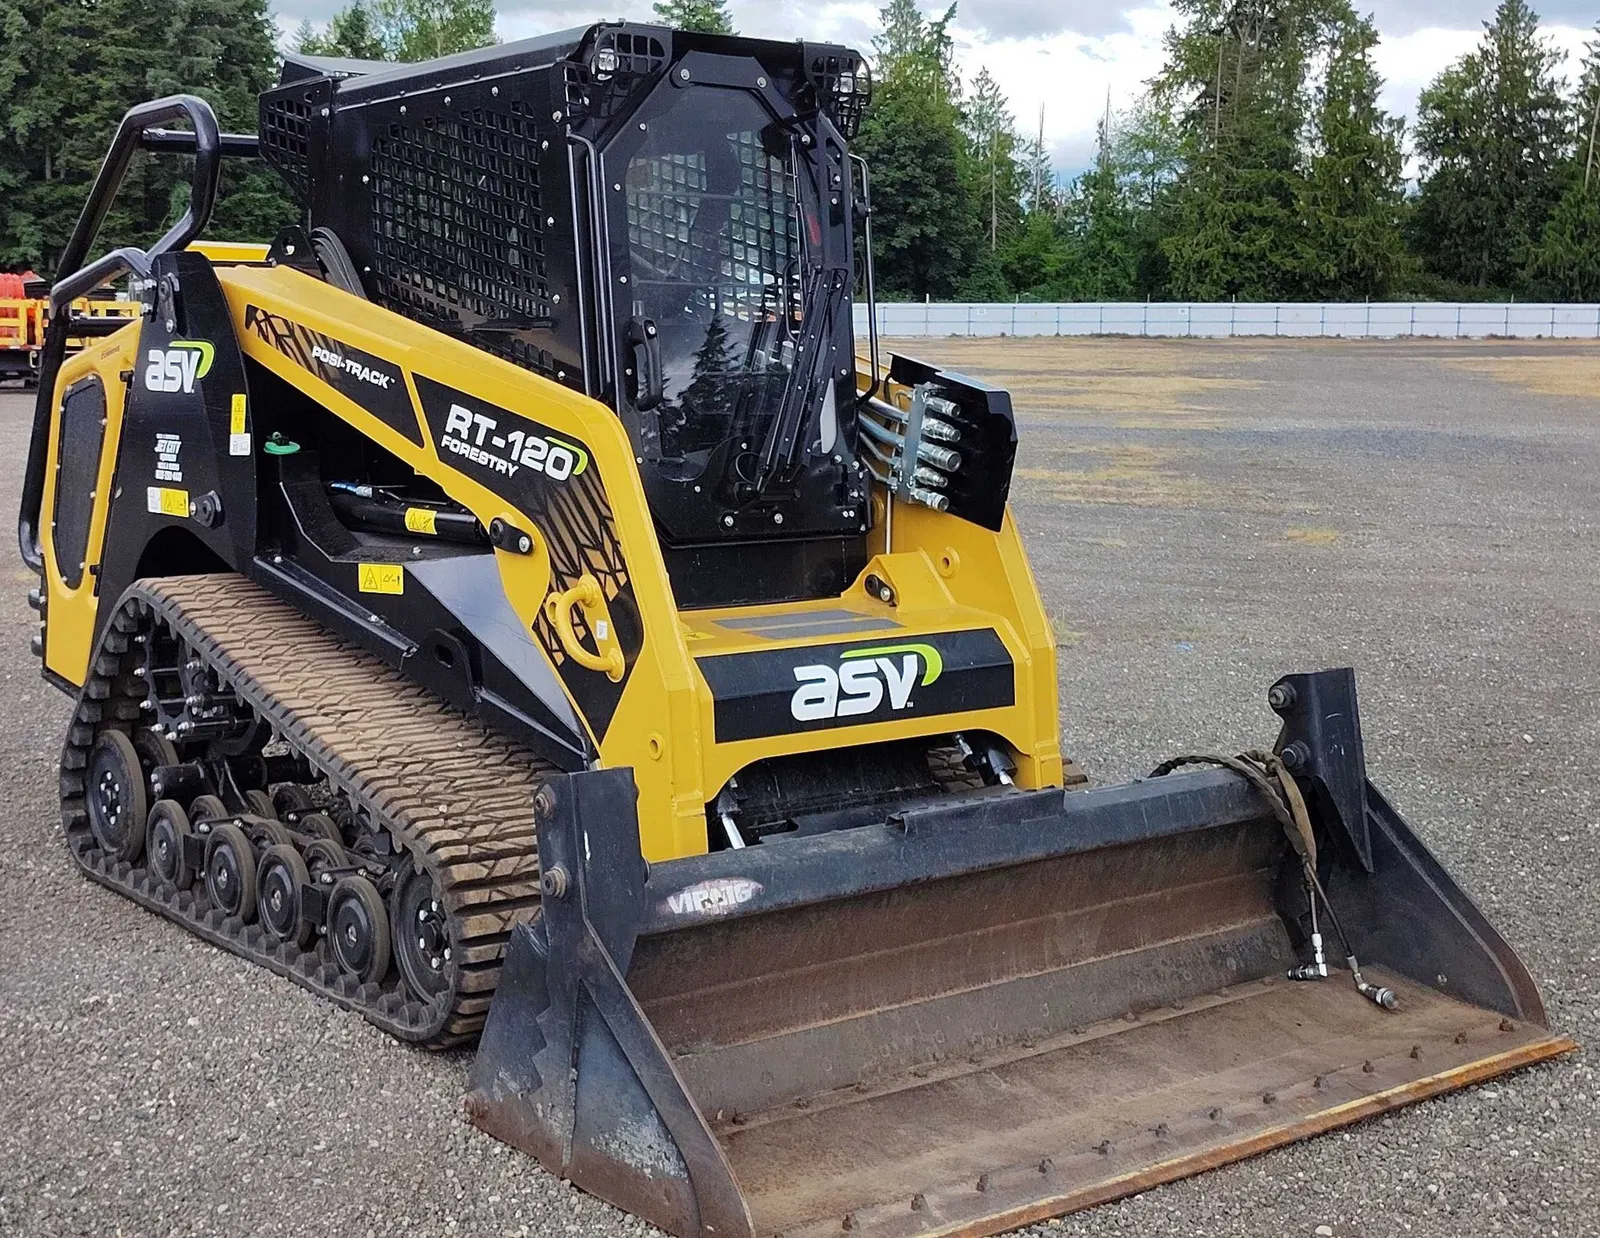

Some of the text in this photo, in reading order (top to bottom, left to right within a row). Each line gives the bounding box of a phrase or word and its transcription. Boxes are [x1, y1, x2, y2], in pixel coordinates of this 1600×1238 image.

[312, 345, 390, 389] POSI-TRACK
[440, 435, 519, 479] FORESTRY
[445, 403, 574, 481] RT-120
[790, 654, 918, 722] asv
